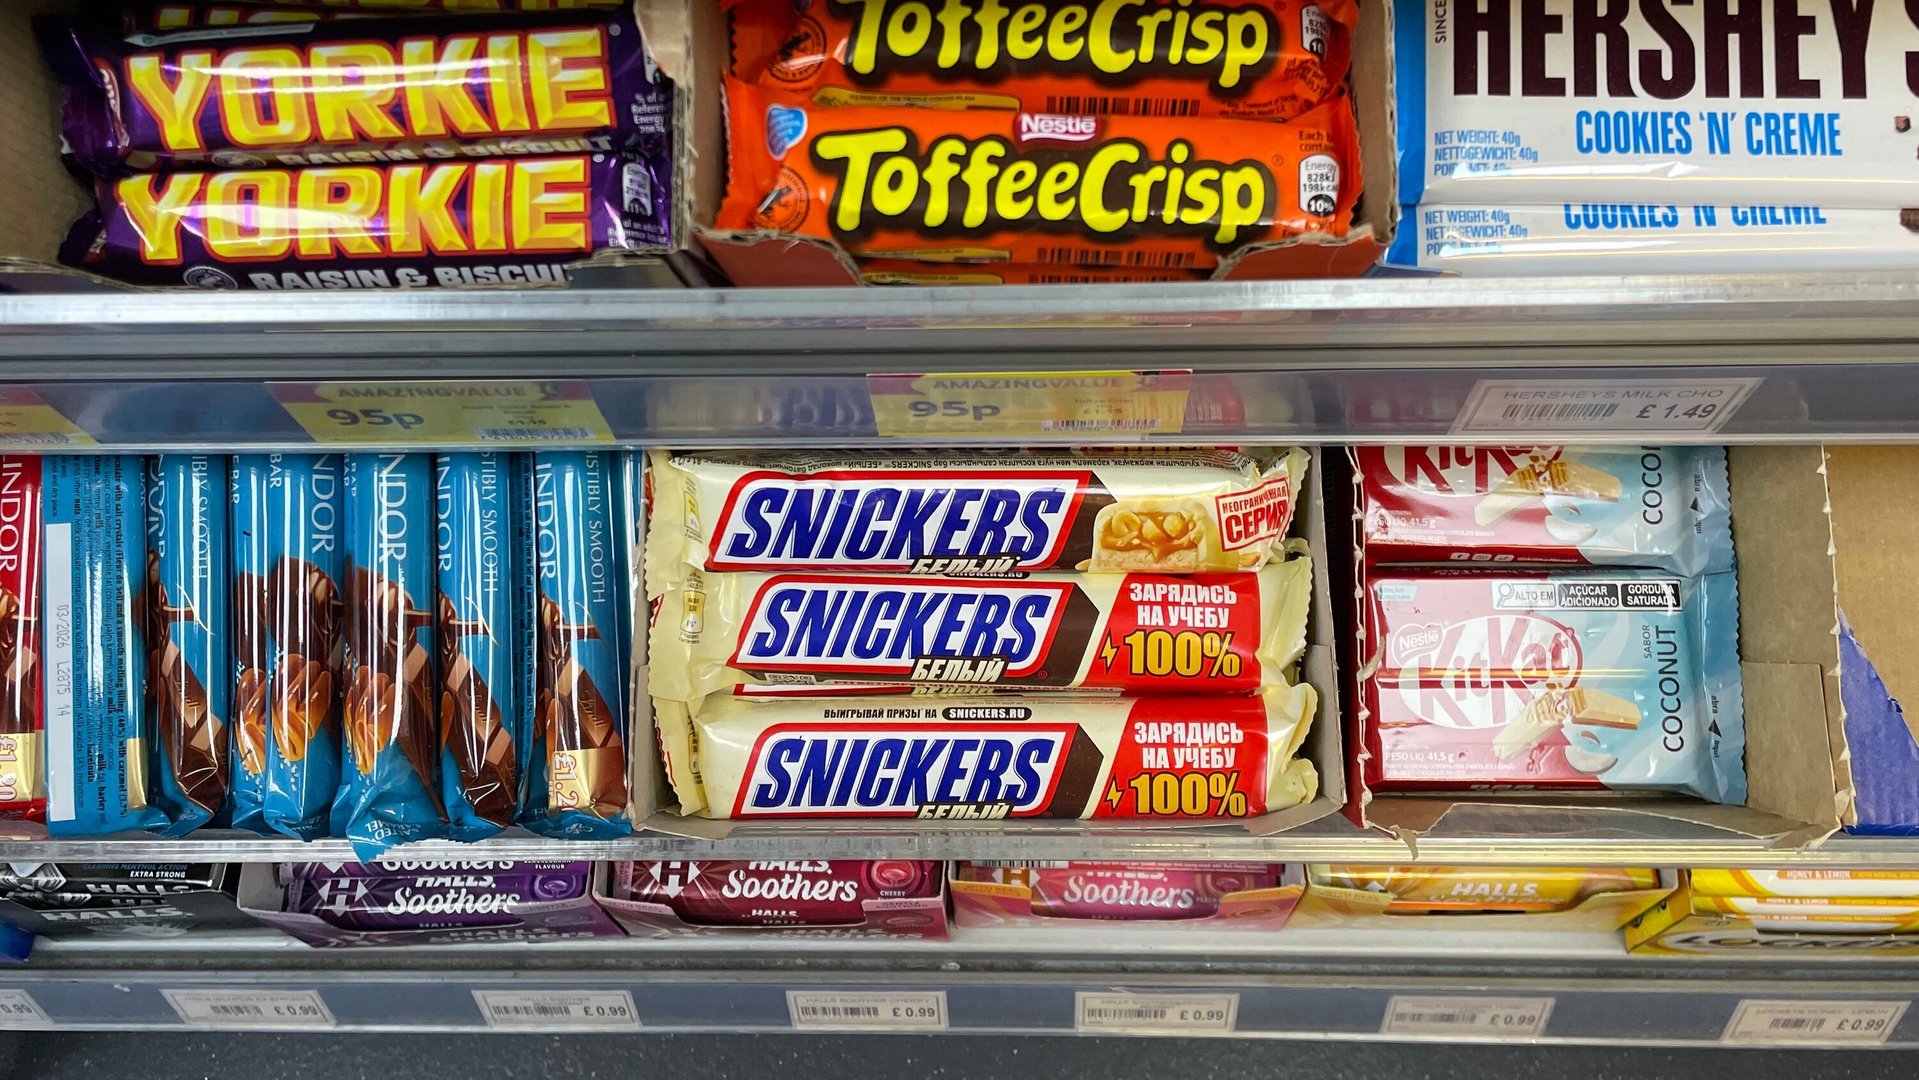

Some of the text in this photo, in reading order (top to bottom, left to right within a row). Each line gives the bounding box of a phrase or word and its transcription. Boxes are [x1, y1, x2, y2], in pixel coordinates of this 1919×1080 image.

[1453, 0, 1919, 100] HERSHEY
[130, 28, 610, 150] YORKIE
[1434, 130, 1521, 147] NET WEIGHT: 40g
[1576, 110, 1691, 156] COOKIES
[1745, 111, 1843, 157] CREME
[1434, 146, 1539, 163] NETTOGEWICHT: 40g
[1306, 162, 1337, 175] Energy
[816, 129, 1266, 244] ToffeeCrisp
[117, 158, 588, 261] YORKIE
[1425, 209, 1511, 225] NET WEIGHT: 40g
[1508, 225, 1528, 240] 40g
[249, 263, 567, 290] RAISIN & BISCUI
[1503, 389, 1725, 399] HERSHEYS MILK CHO
[327, 408, 424, 430] 95p
[908, 400, 1001, 421] 95p
[1635, 403, 1718, 419] £ 1.49
[933, 459, 948, 470] бар
[0, 455, 23, 573] INDOR
[311, 454, 335, 555] NDOR
[378, 453, 408, 564] NDOR
[437, 456, 452, 573] INDOR
[535, 463, 557, 580] INDOR
[727, 487, 1067, 561] SNICKERS
[1225, 499, 1288, 544] СЕРИЯ
[74, 535, 84, 572] chocolate
[482, 509, 499, 593] SMOOTH
[588, 519, 606, 604] SMOOTH
[1130, 583, 1237, 607] ЗАРЯДИСЬ
[1514, 589, 1554, 601] ALTO EM
[1560, 595, 1618, 608] ADICIONADO
[1568, 583, 1608, 598] AÇÚCAR
[1627, 584, 1675, 596] GORDURA
[1627, 594, 1677, 607] SATURADA
[748, 588, 1052, 662] SNICKERS
[1137, 605, 1230, 629] НА УЧЕБУ
[1643, 624, 1651, 659] SABOR
[56, 604, 71, 718] 03/2026 L2875 14
[1125, 630, 1241, 678] 100%
[911, 657, 1007, 683] БЕЛЫЙ
[1656, 624, 1685, 752] COCONUT
[824, 707, 885, 720] ВЫИГРЫВАЙ
[924, 708, 937, 719] НА
[949, 707, 1025, 719] SNICKERS.RU
[1134, 722, 1244, 746] ЗАРЯДИСЬ
[1142, 747, 1236, 770] НА УЧЕБУ
[1385, 751, 1455, 763] PESO 41,5 g
[117, 760, 127, 792] caramel
[751, 737, 1055, 808] SNICKERS
[1130, 772, 1246, 817] 100%
[917, 802, 1010, 820] БЕЛЫЙ
[722, 869, 858, 902] Soothers
[1064, 875, 1194, 910] Soothers
[1451, 883, 1538, 897] HALLS
[387, 886, 521, 915] Soothers
[286, 1005, 318, 1016] 0.99
[583, 1006, 627, 1016] £ 0.99
[893, 1007, 936, 1018] £ 0.99
[1180, 1010, 1224, 1020] £ 0.99
[1489, 1014, 1536, 1025] £ 0.99
[1836, 1019, 1885, 1030] £ 0.99
